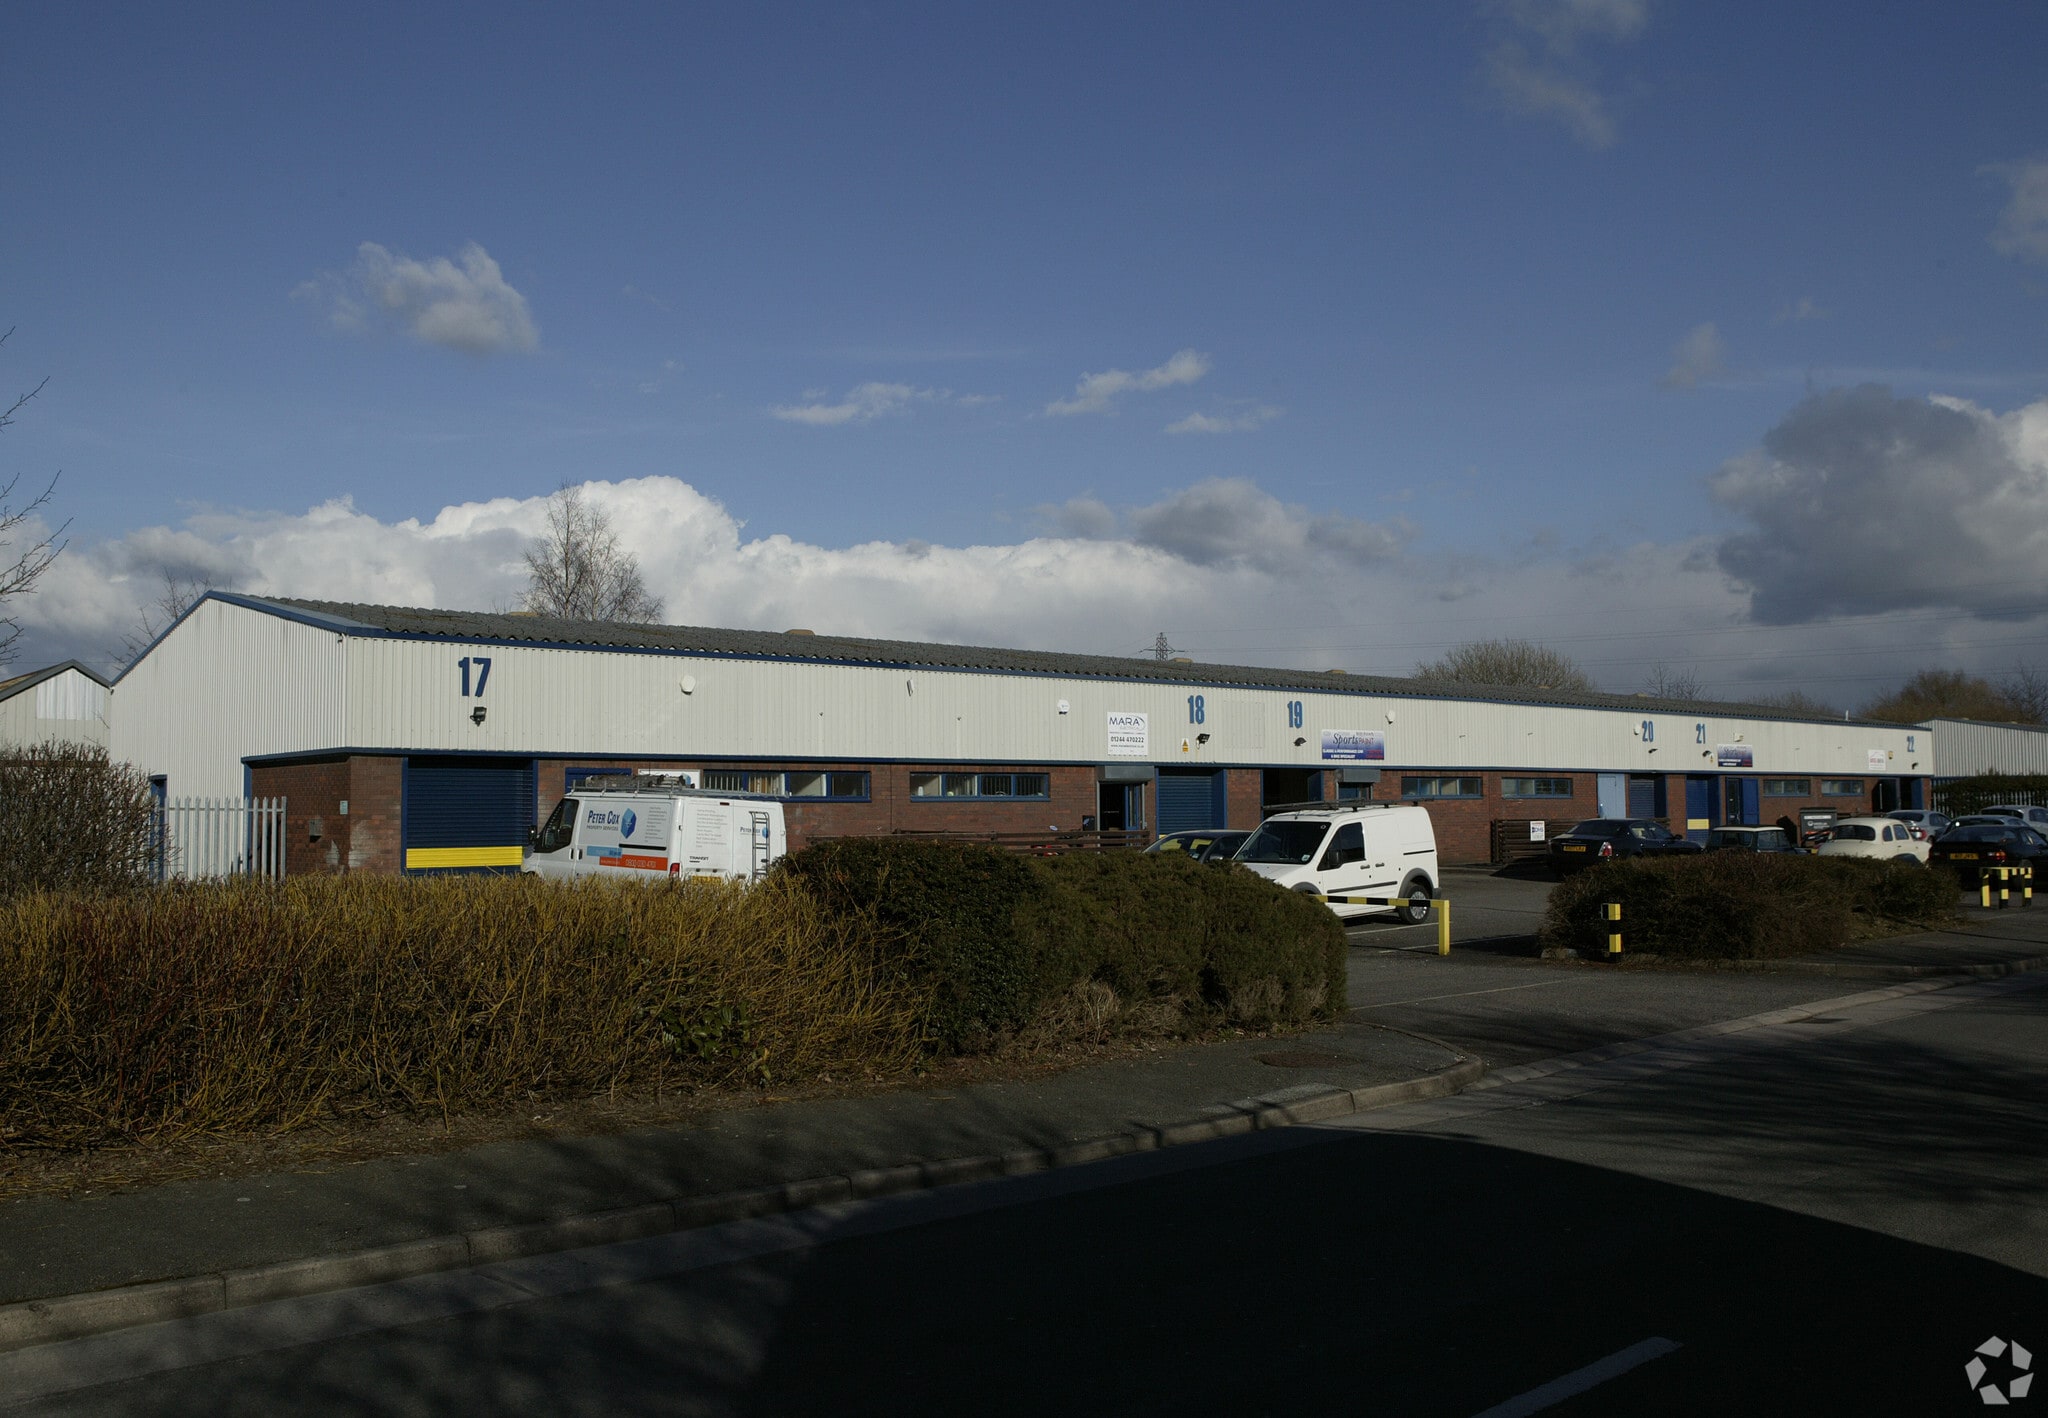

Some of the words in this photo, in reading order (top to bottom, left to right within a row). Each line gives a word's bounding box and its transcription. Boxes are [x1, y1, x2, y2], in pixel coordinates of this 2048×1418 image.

[458, 656, 492, 698] 17
[1187, 694, 1205, 725] 18
[1287, 700, 1303, 729] 19
[1109, 717, 1140, 726] MARA
[1641, 720, 1654, 743] 20
[1332, 732, 1359, 749] Sports
[1696, 723, 1706, 744] 21
[1906, 735, 1915, 753] 22
